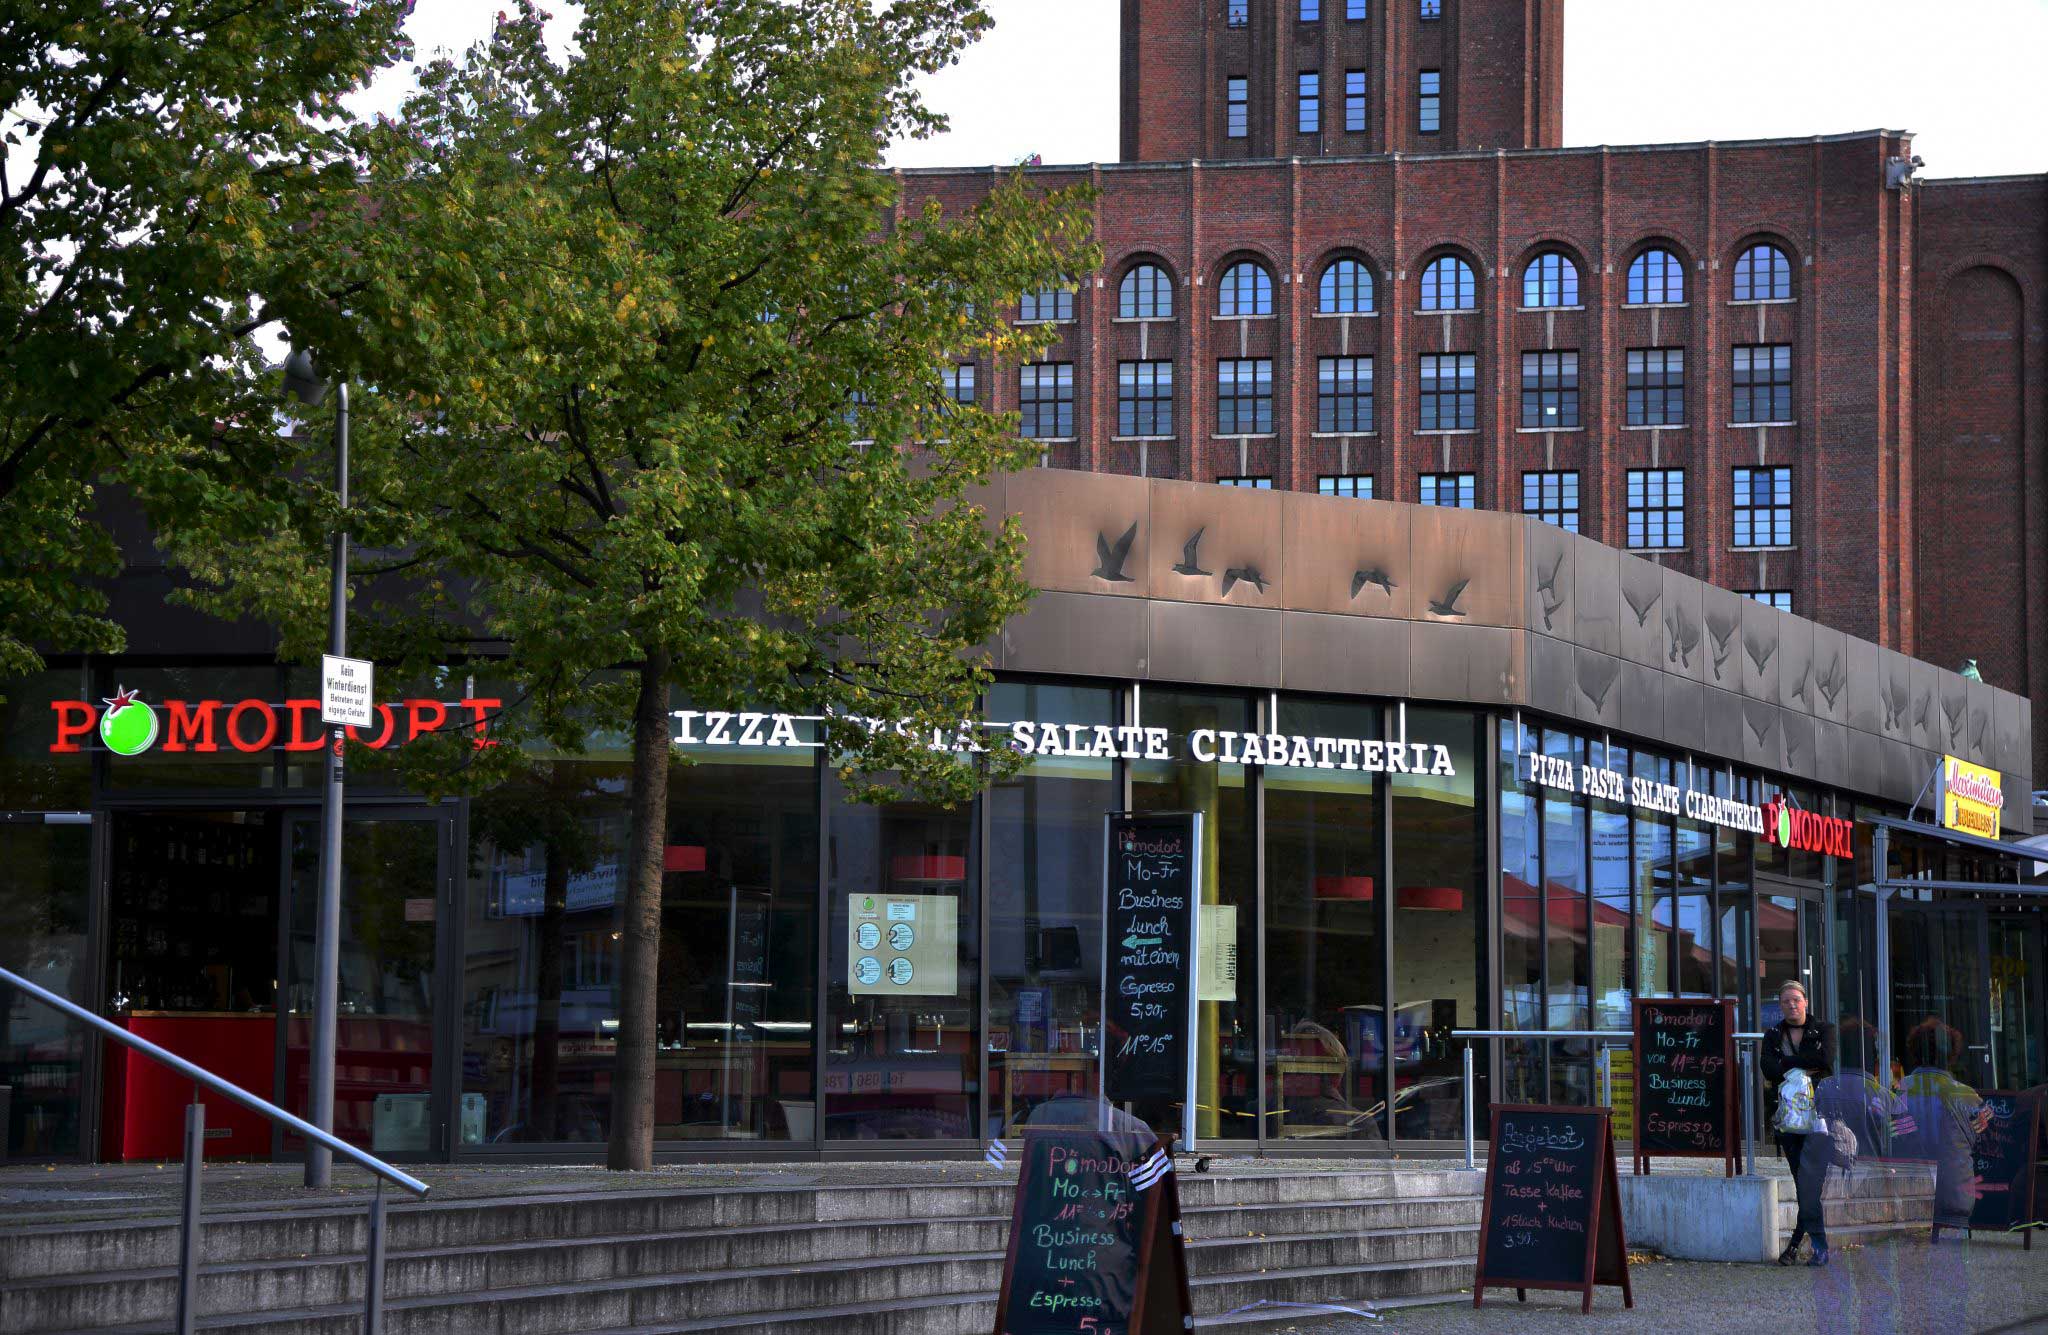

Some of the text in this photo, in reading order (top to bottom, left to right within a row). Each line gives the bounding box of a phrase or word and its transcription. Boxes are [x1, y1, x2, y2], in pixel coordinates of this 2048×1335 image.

[341, 664, 354, 677] Kein
[327, 677, 367, 694] Winterdienst
[330, 693, 364, 706] Betreten auf
[328, 706, 366, 718] eigene Gefahr
[673, 710, 800, 746] IZZA
[1012, 721, 1169, 760] SALATE
[1192, 729, 1456, 776] CIABATTERIA
[1530, 752, 1764, 834] PIZZA PASTA SALATE CIABATTERIA
[1118, 888, 1184, 910] Business
[1127, 914, 1171, 937] Lunch
[1120, 976, 1175, 999] Espresso
[1646, 1007, 1715, 1026] Pomodori
[1647, 1053, 1666, 1065] von
[1648, 1074, 1706, 1090] Business
[1667, 1090, 1711, 1107] Lunch
[1647, 1113, 1713, 1137] Espresso
[1554, 1161, 1577, 1174] Uhr
[1053, 1177, 1126, 1200] Mo Fr
[1502, 1181, 1584, 1203] Tasse Kaffee
[1548, 1215, 1584, 1232] Kuchen
[1032, 1223, 1116, 1248] Business
[1046, 1250, 1097, 1272] Lunch
[1029, 1291, 1102, 1312] Espresso
